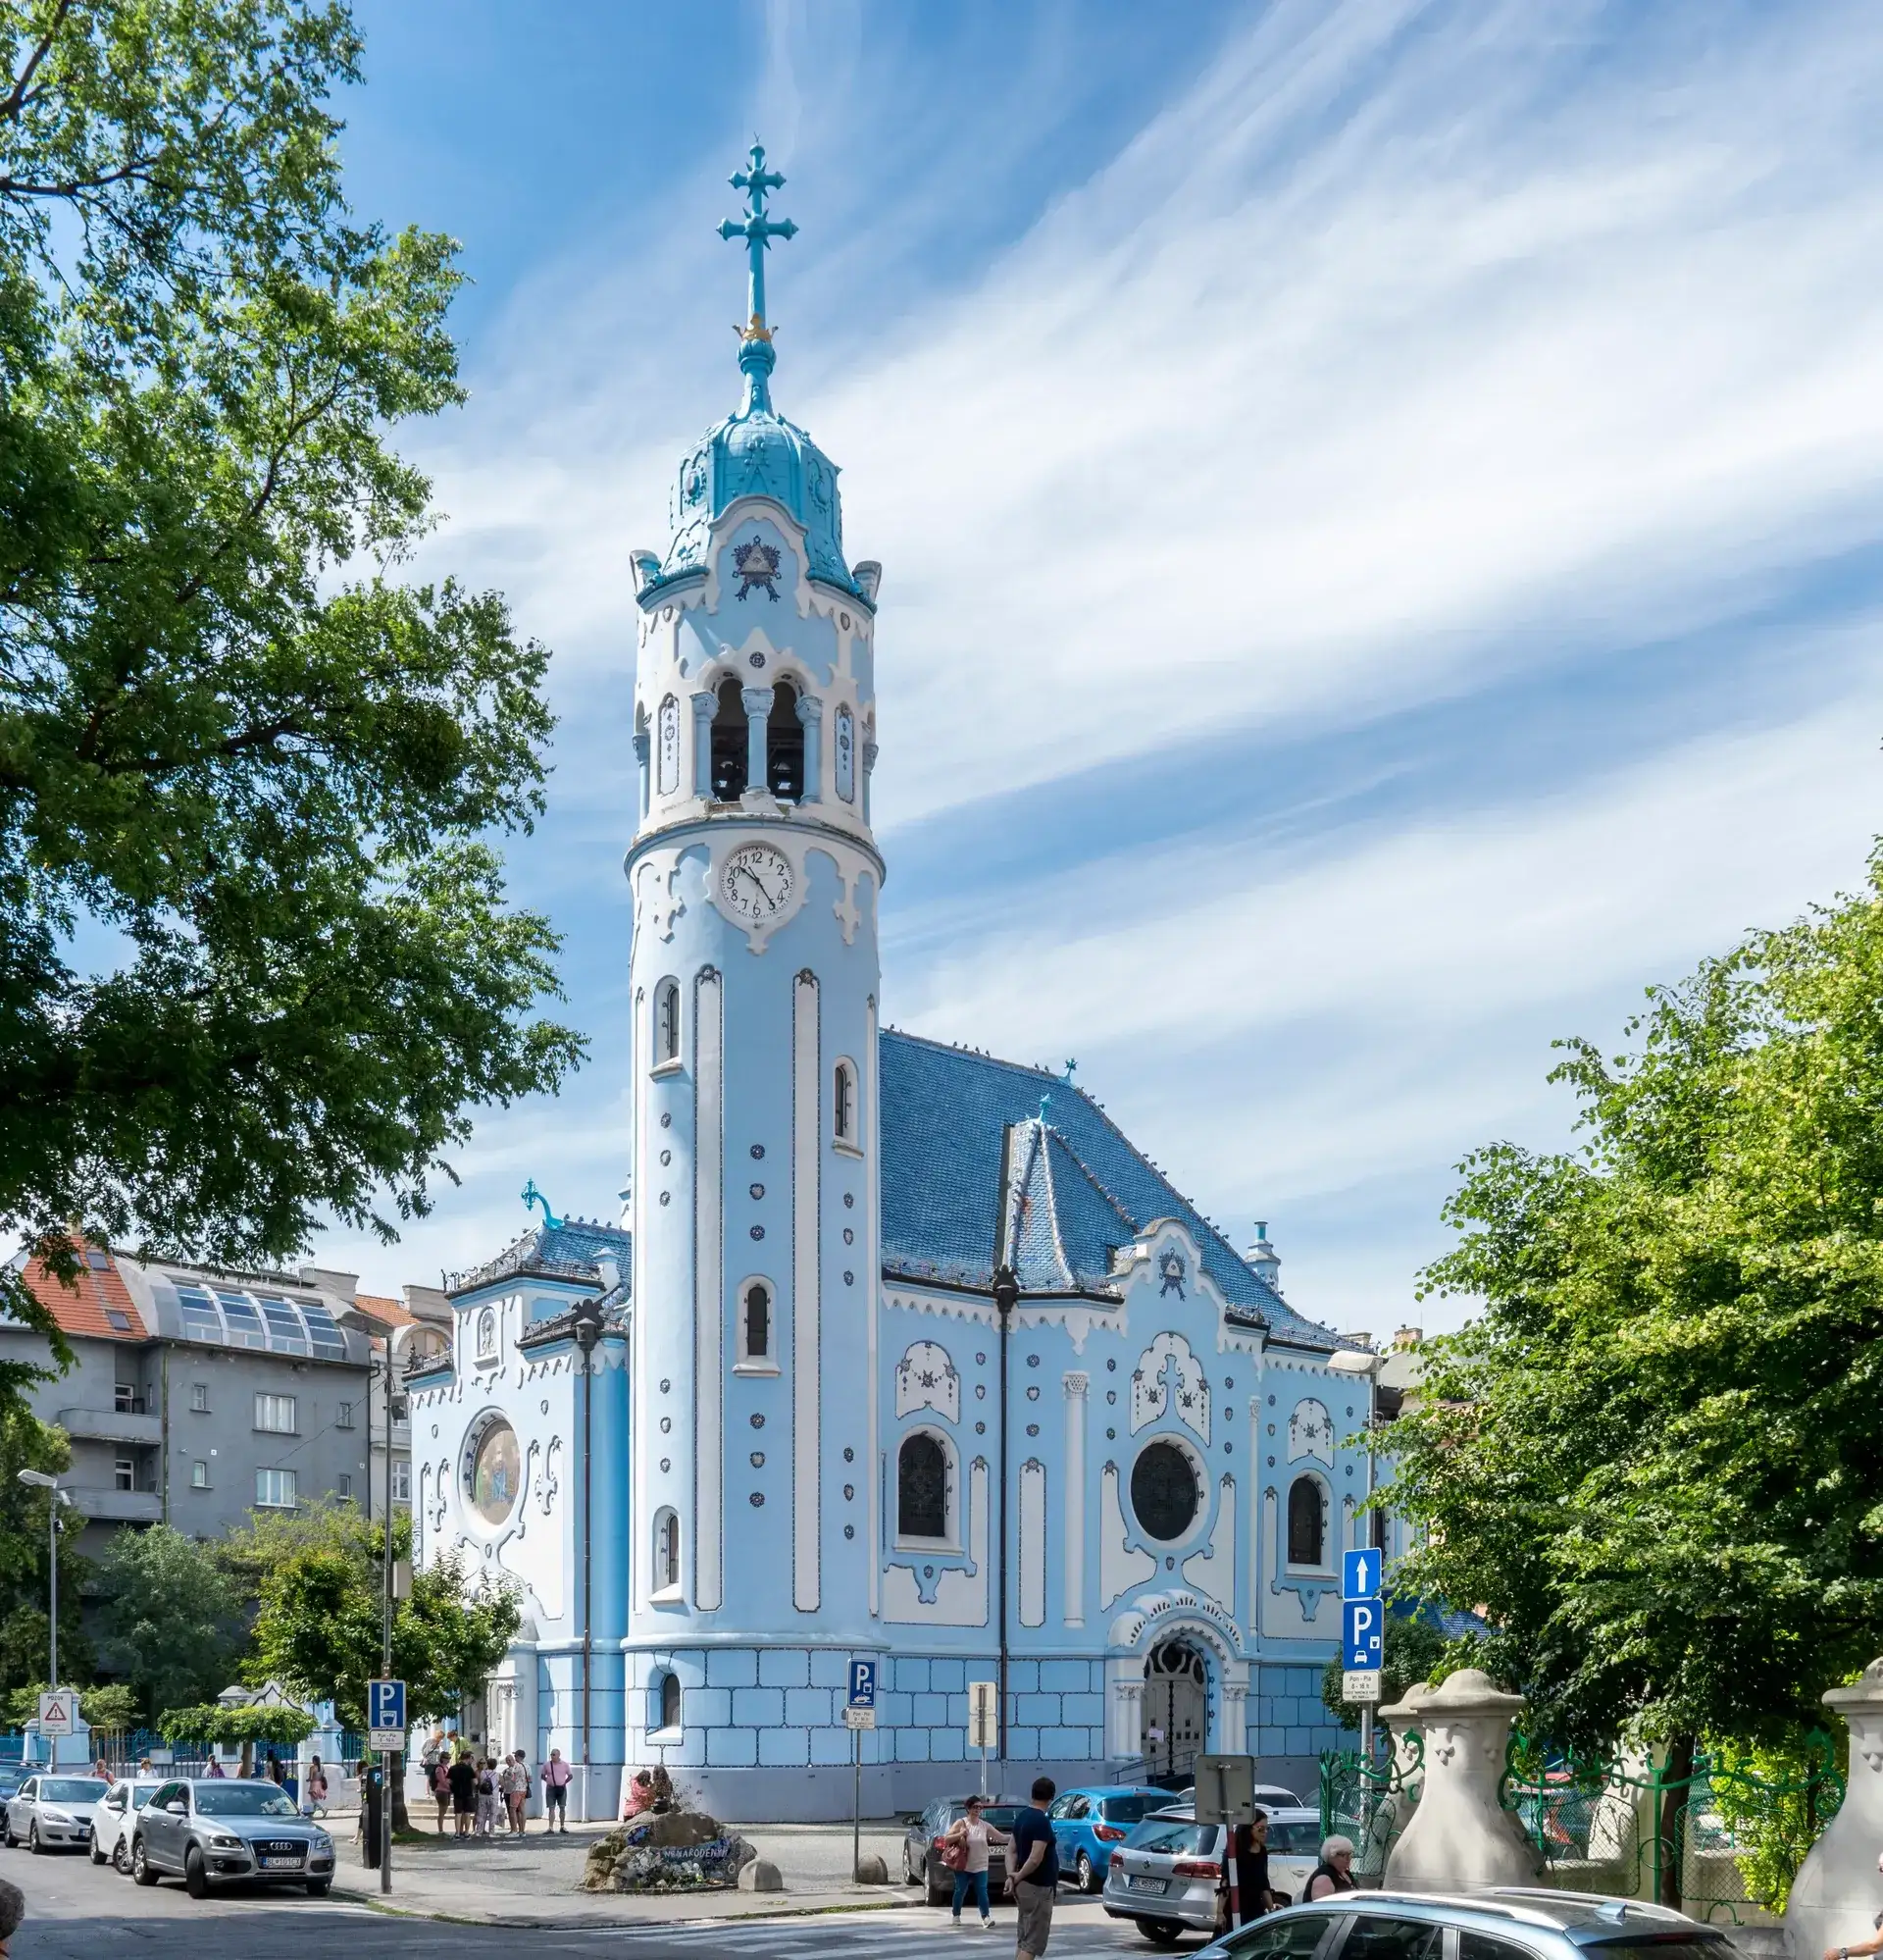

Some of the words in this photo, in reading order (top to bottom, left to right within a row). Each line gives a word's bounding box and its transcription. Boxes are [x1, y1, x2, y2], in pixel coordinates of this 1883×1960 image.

[737, 854, 747, 866] 11
[751, 851, 763, 864] 12
[769, 856, 774, 867] 1
[729, 865, 740, 878] 10
[777, 863, 785, 876] 2
[727, 877, 735, 889] 9
[783, 879, 789, 890] 3
[731, 889, 738, 902] 8
[777, 890, 785, 903] 4
[740, 899, 748, 909] 7
[753, 901, 761, 915] 6
[1353, 1606, 1372, 1645] P
[856, 1664, 870, 1691] P
[379, 1683, 395, 1710] P
[375, 1773, 382, 1782] P
